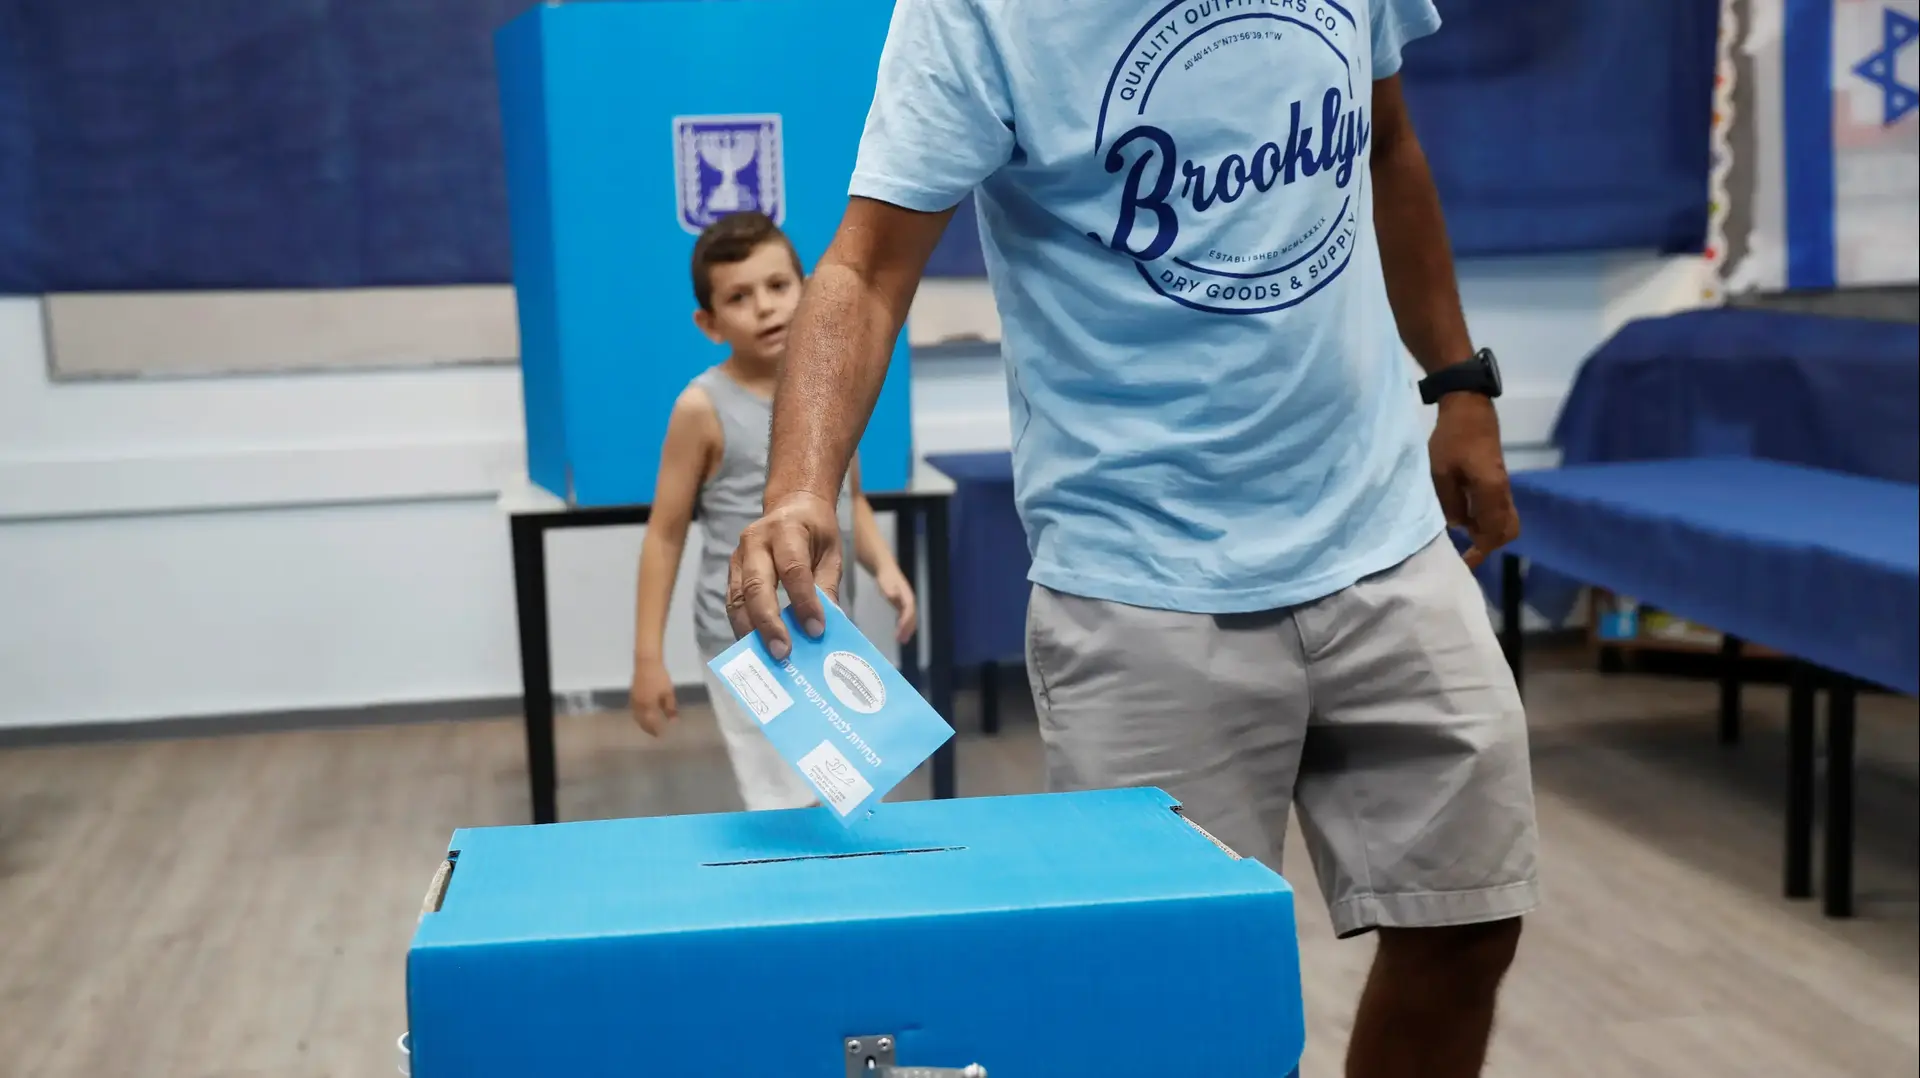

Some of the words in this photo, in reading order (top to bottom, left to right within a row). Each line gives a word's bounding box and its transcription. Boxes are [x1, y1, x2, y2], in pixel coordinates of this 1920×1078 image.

[1120, 21, 1179, 101] QUALITY
[1184, 0, 1307, 24] OUTFRS
[1315, 7, 1338, 36] CO.
[1159, 268, 1200, 294] DRY
[1206, 283, 1281, 300] GOODS
[1290, 275, 1303, 290] &
[1308, 211, 1355, 279] SUPPLY
[1208, 249, 1279, 263] ESTABLISHED
[793, 674, 828, 710] העשרים
[821, 706, 852, 734] לכנסת
[846, 731, 882, 768] הבחירות
